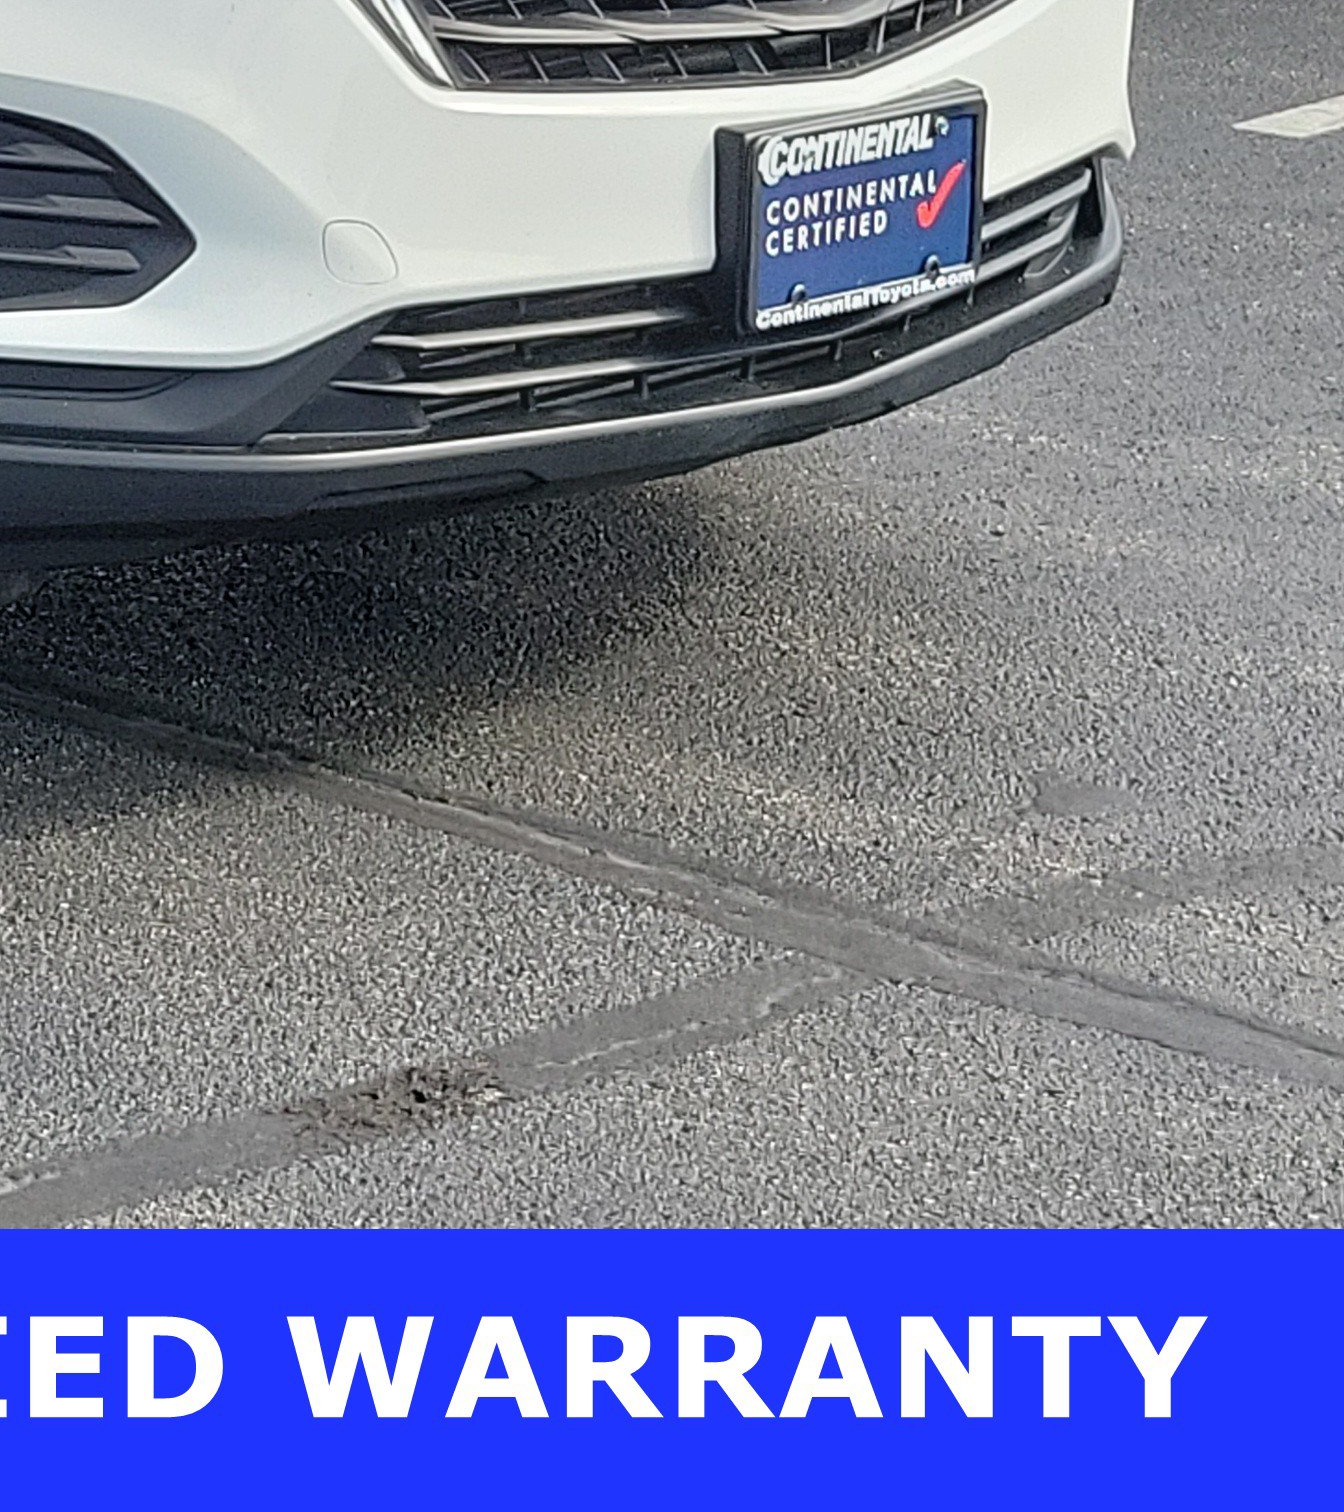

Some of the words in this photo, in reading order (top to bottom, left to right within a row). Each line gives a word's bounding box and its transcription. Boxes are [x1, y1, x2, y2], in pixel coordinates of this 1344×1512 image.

[757, 113, 934, 187] CONTINENTAL
[766, 168, 938, 227] CONTINENTAL
[765, 208, 889, 257] CERTIFIED
[755, 268, 977, 331] ContinentalToyota.com
